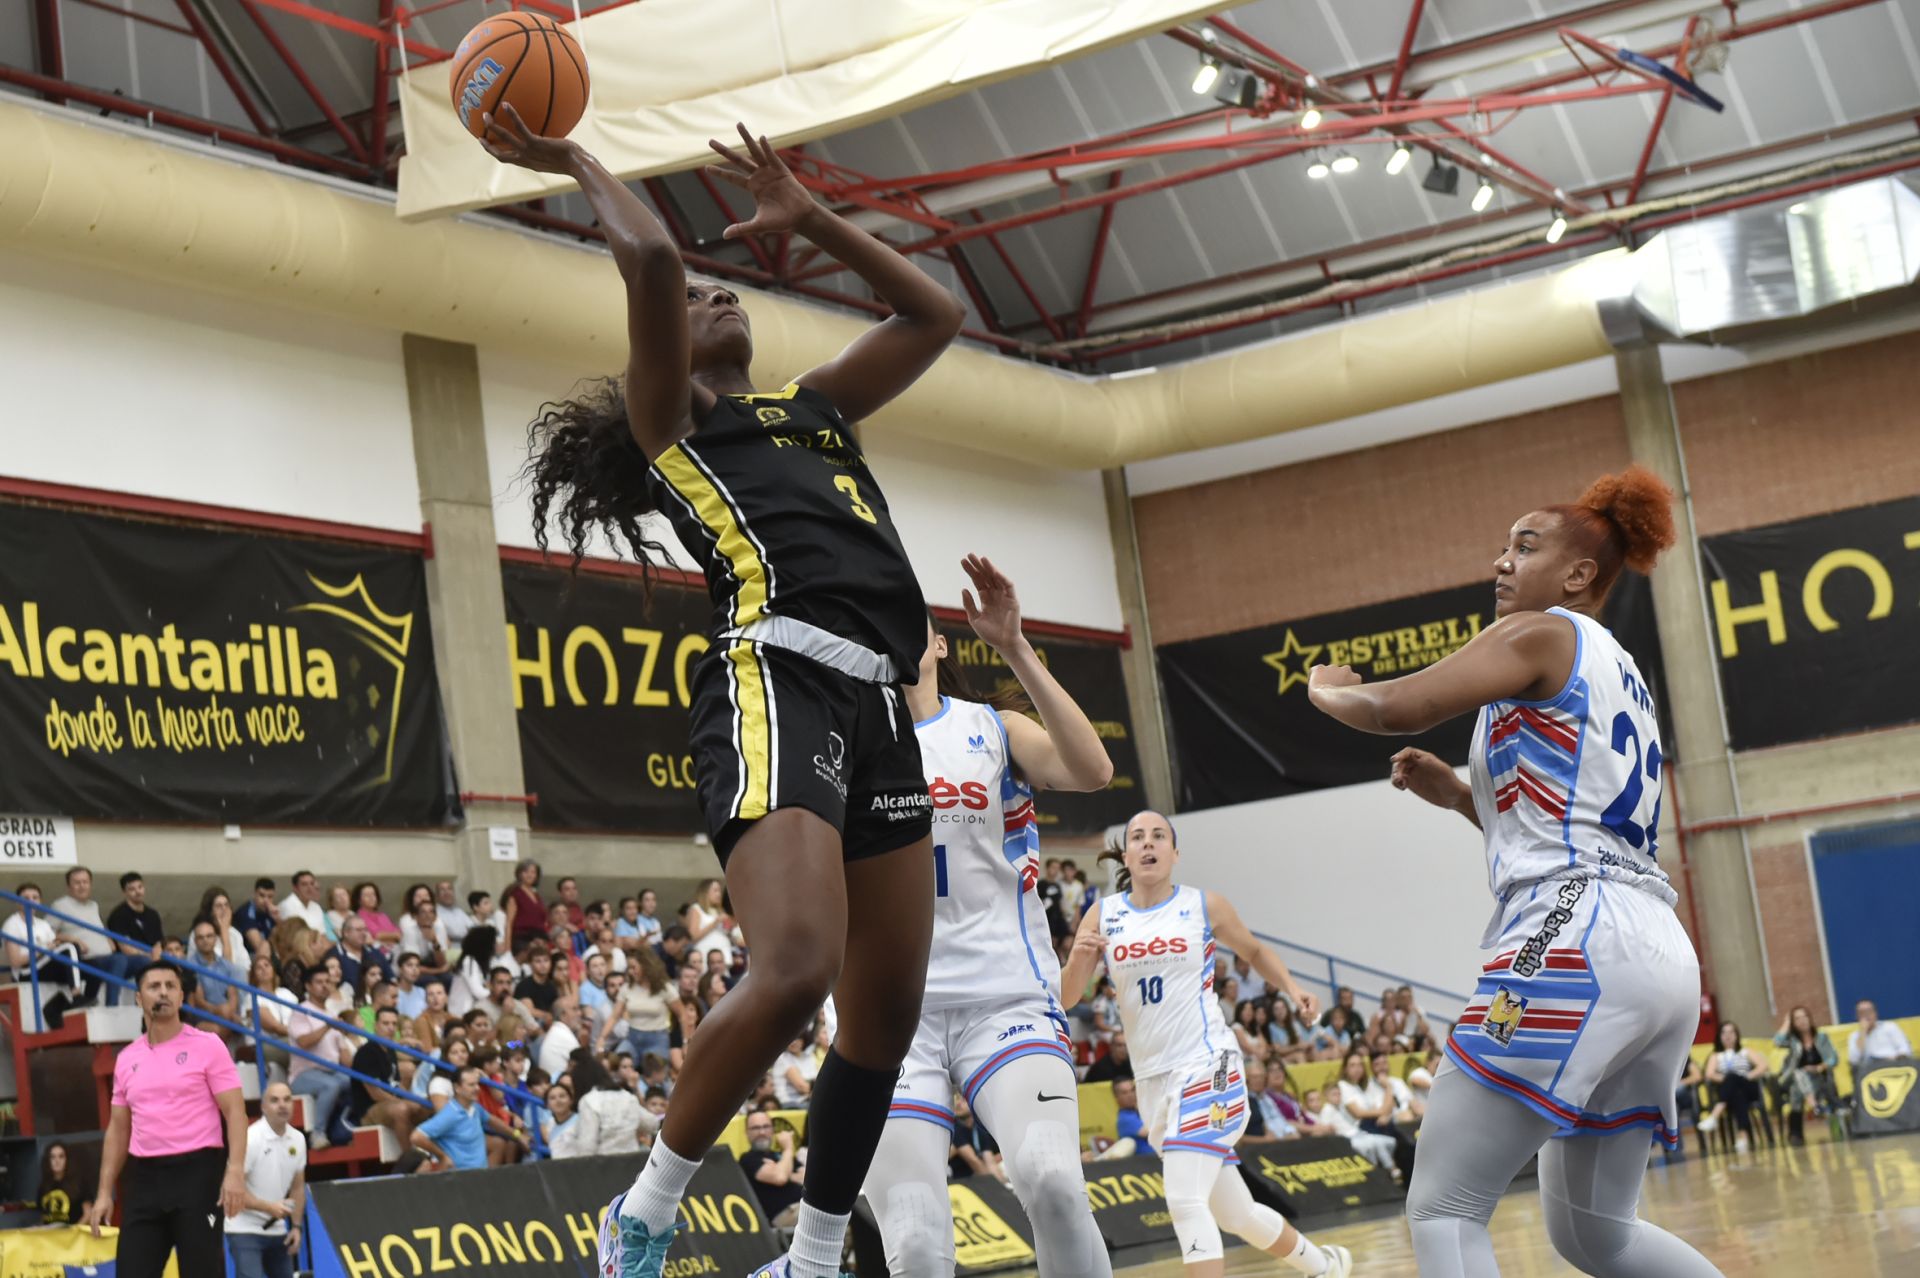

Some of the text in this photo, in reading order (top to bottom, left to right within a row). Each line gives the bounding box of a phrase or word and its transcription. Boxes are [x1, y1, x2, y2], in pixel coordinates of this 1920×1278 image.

[833, 474, 878, 524] 3
[1711, 530, 1920, 658] HO
[45, 694, 305, 758] donde la huerta nace
[1600, 711, 1663, 862] 22
[0, 816, 57, 836] GRADA
[4, 840, 54, 858] OESTE
[1137, 975, 1164, 1006] 10
[340, 1219, 564, 1278] HOZONO
[662, 1253, 721, 1278] GLOBAL
